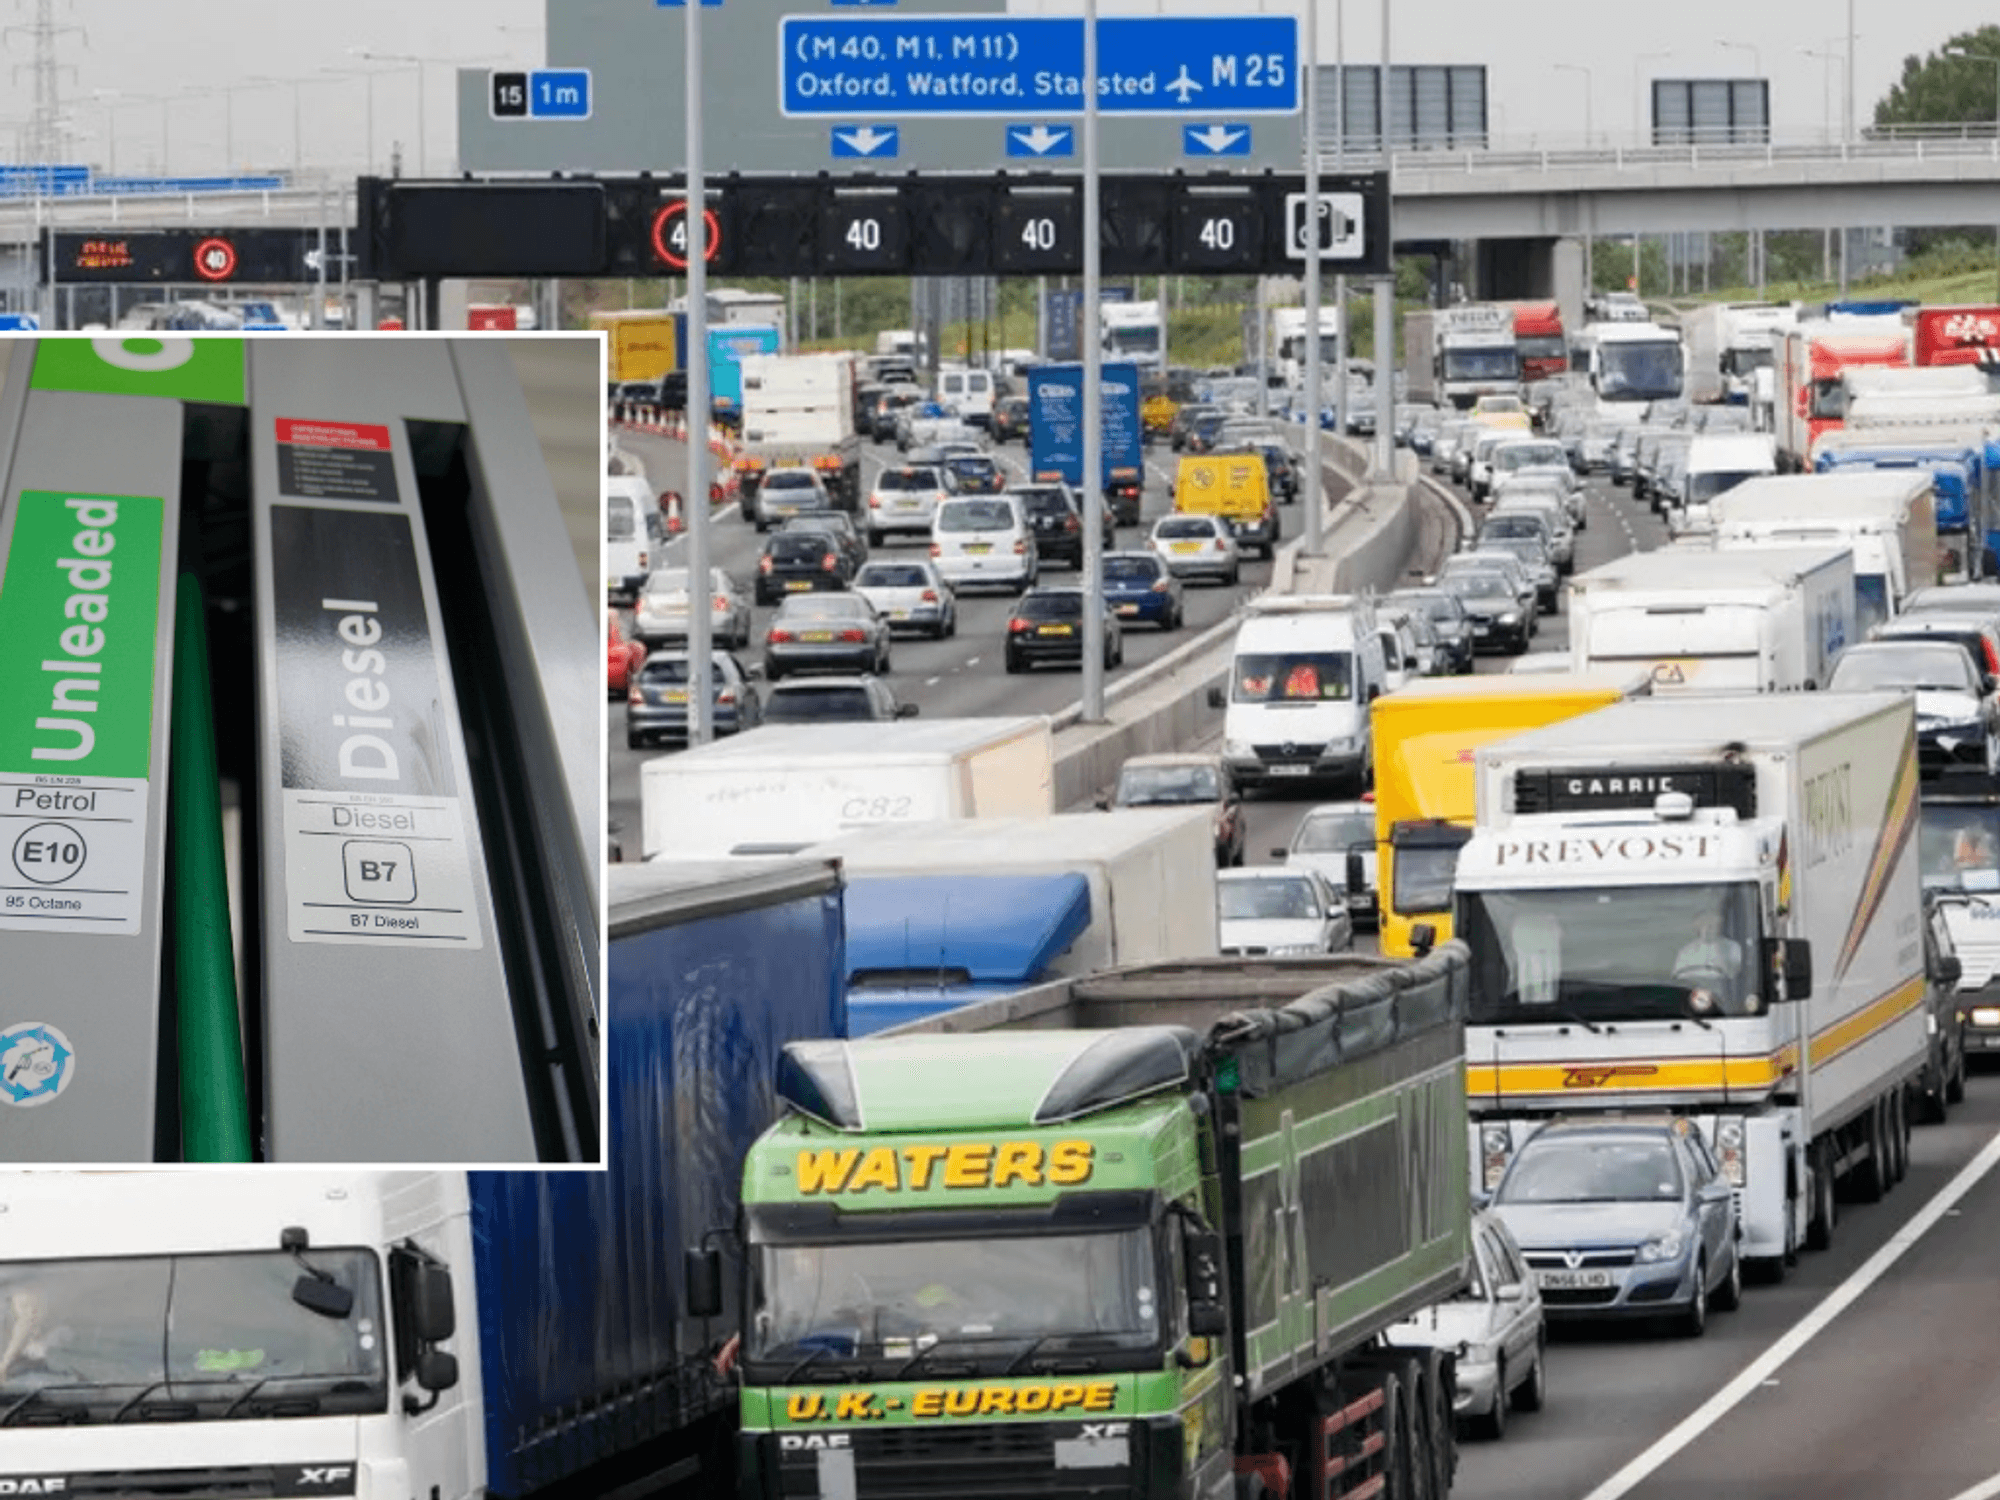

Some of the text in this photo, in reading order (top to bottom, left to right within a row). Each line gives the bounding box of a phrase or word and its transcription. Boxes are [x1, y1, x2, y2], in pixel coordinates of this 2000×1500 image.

[952, 32, 1019, 61] M11)
[1211, 53, 1285, 88] M25
[499, 86, 522, 105] 15
[541, 81, 579, 105] 1m
[796, 70, 1156, 98] Oxford, Watford, Stasted
[845, 218, 880, 250] 40
[1021, 218, 1056, 250] 40
[1199, 218, 1234, 250] 40
[31, 498, 118, 761] Unleaded
[322, 598, 400, 781] Diesel
[15, 788, 96, 812] Petrol
[842, 795, 912, 819] C82
[332, 806, 416, 831] Diesel
[23, 841, 80, 864] E10
[1497, 833, 1721, 866] PREVOST
[360, 860, 398, 882] B7
[5, 896, 82, 911] 95 Octane
[350, 913, 420, 929] B7 Diesel
[797, 1140, 1096, 1195] WATERS
[911, 1380, 1119, 1418] EUROPE
[780, 1433, 851, 1450] DAF
[1082, 1422, 1131, 1438] XF
[0, 1478, 66, 1494] DAF
[298, 1468, 352, 1485] XF
